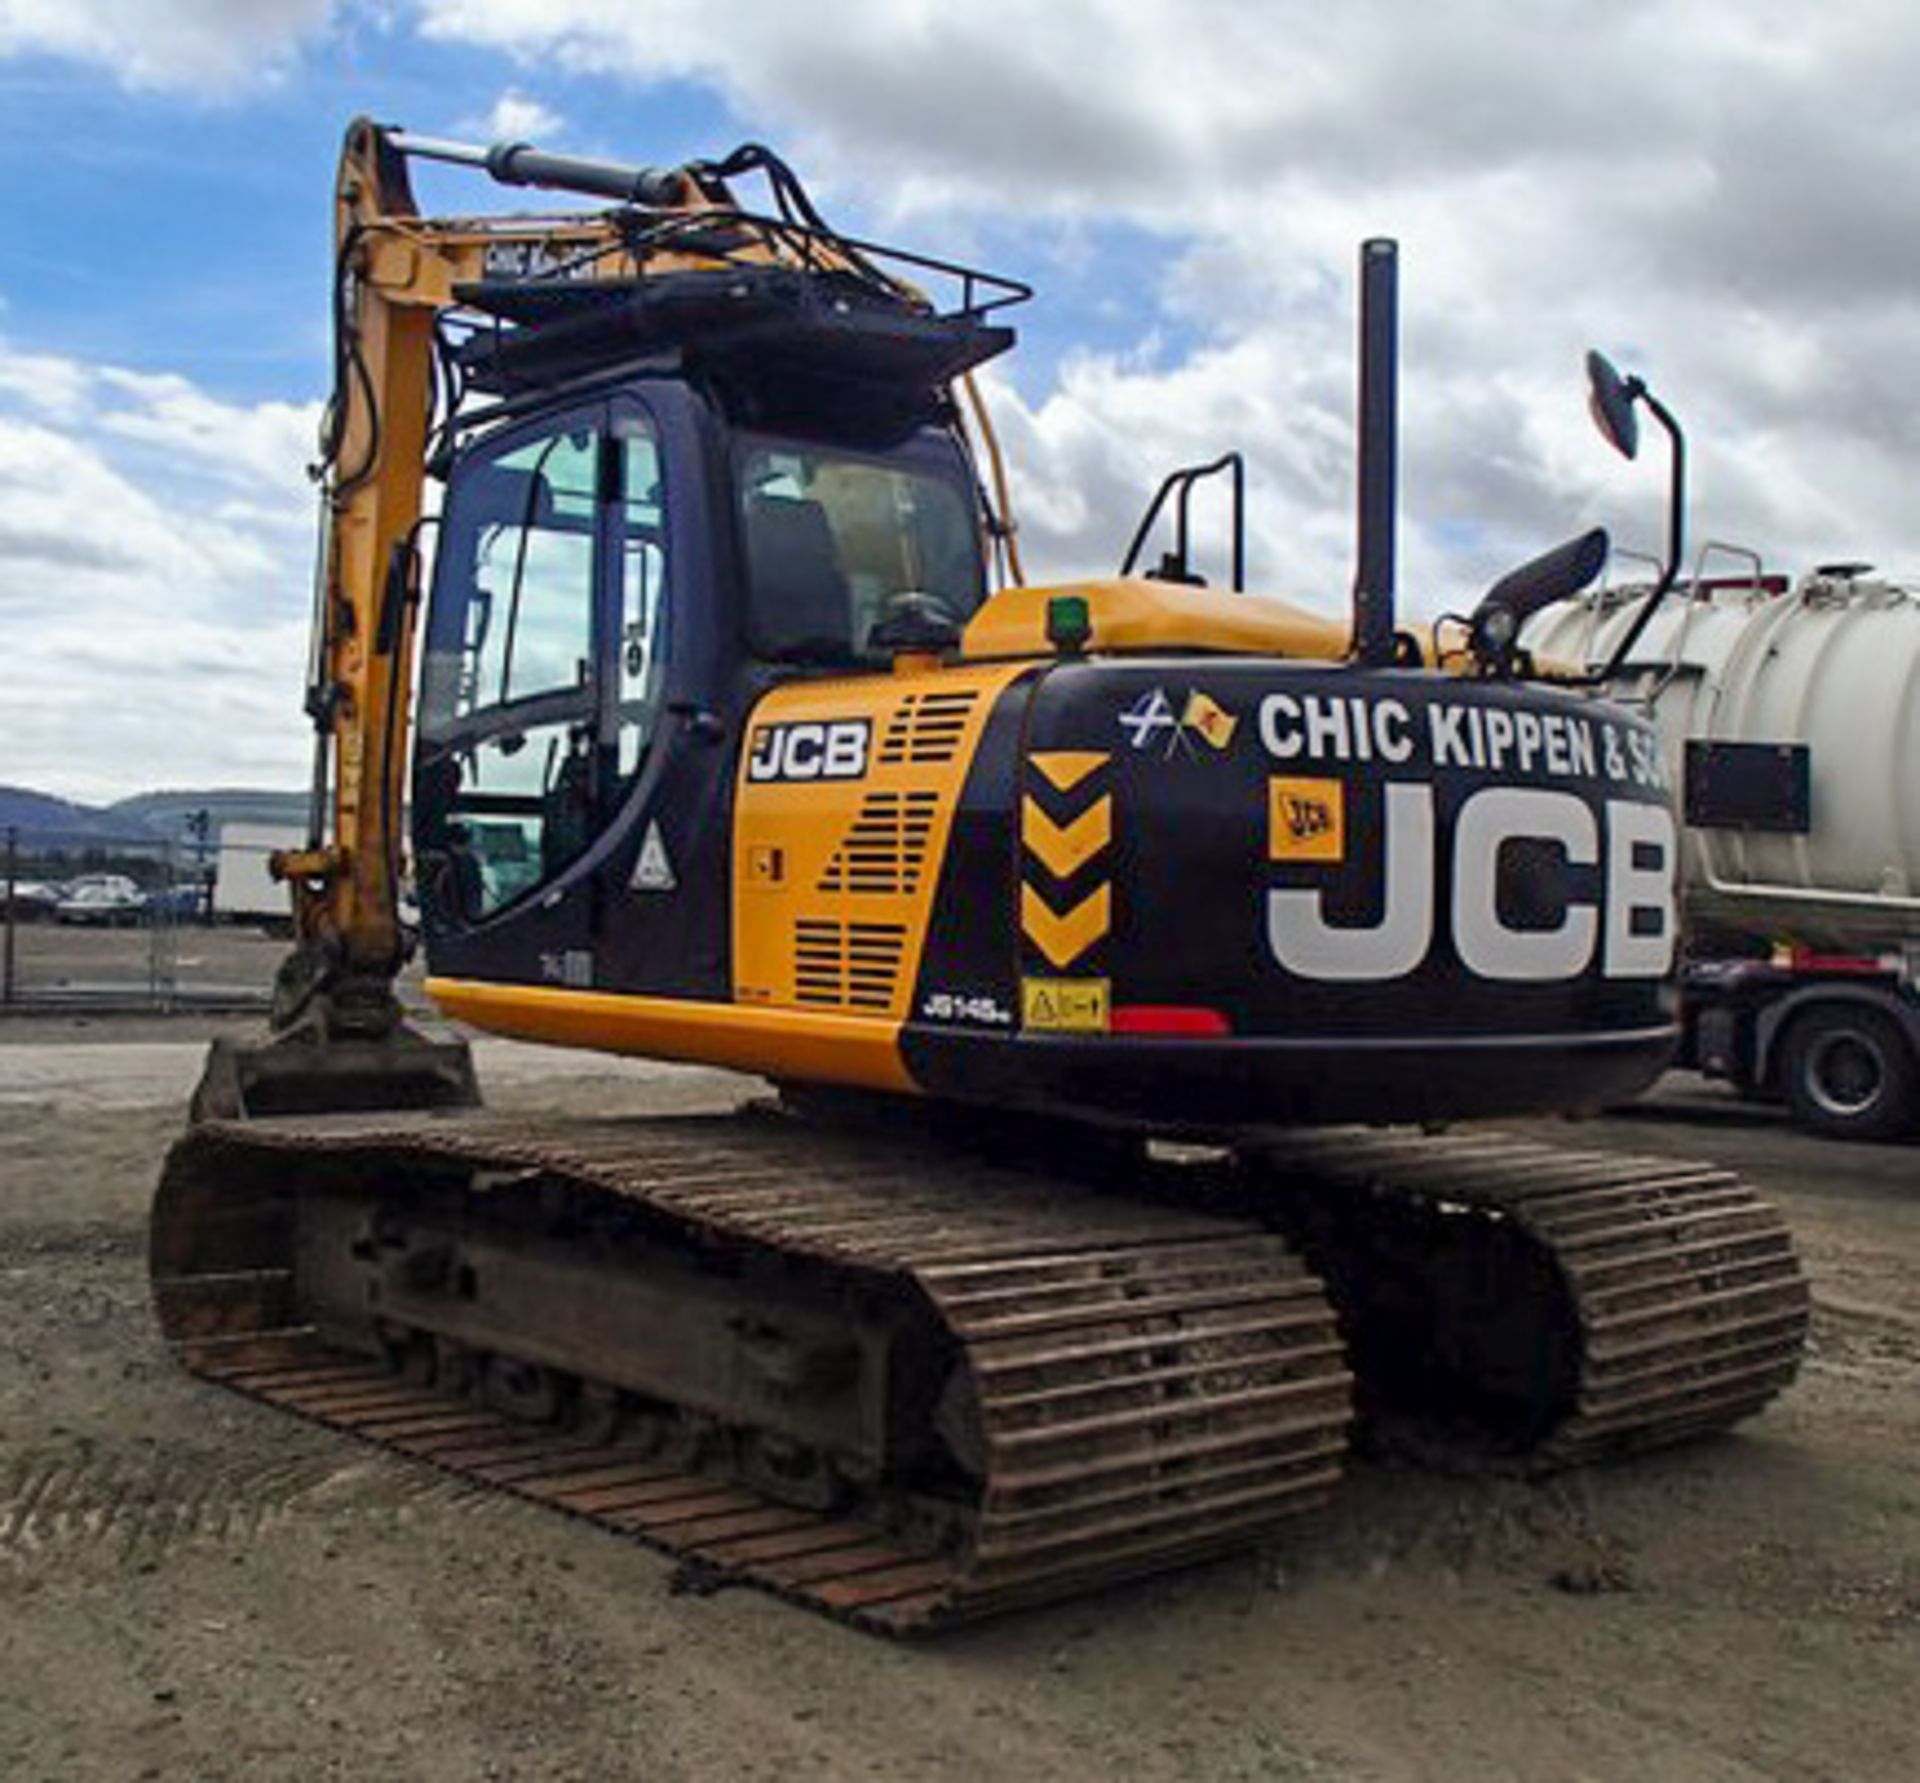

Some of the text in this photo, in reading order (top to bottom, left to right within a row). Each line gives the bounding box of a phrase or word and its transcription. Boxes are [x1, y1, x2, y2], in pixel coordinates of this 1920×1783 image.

[750, 723, 867, 780] JCB
[1259, 694, 1413, 760] CHIC
[1430, 704, 1597, 777] KIPPEN
[1602, 723, 1628, 781] &
[1268, 782, 1676, 980] JCB
